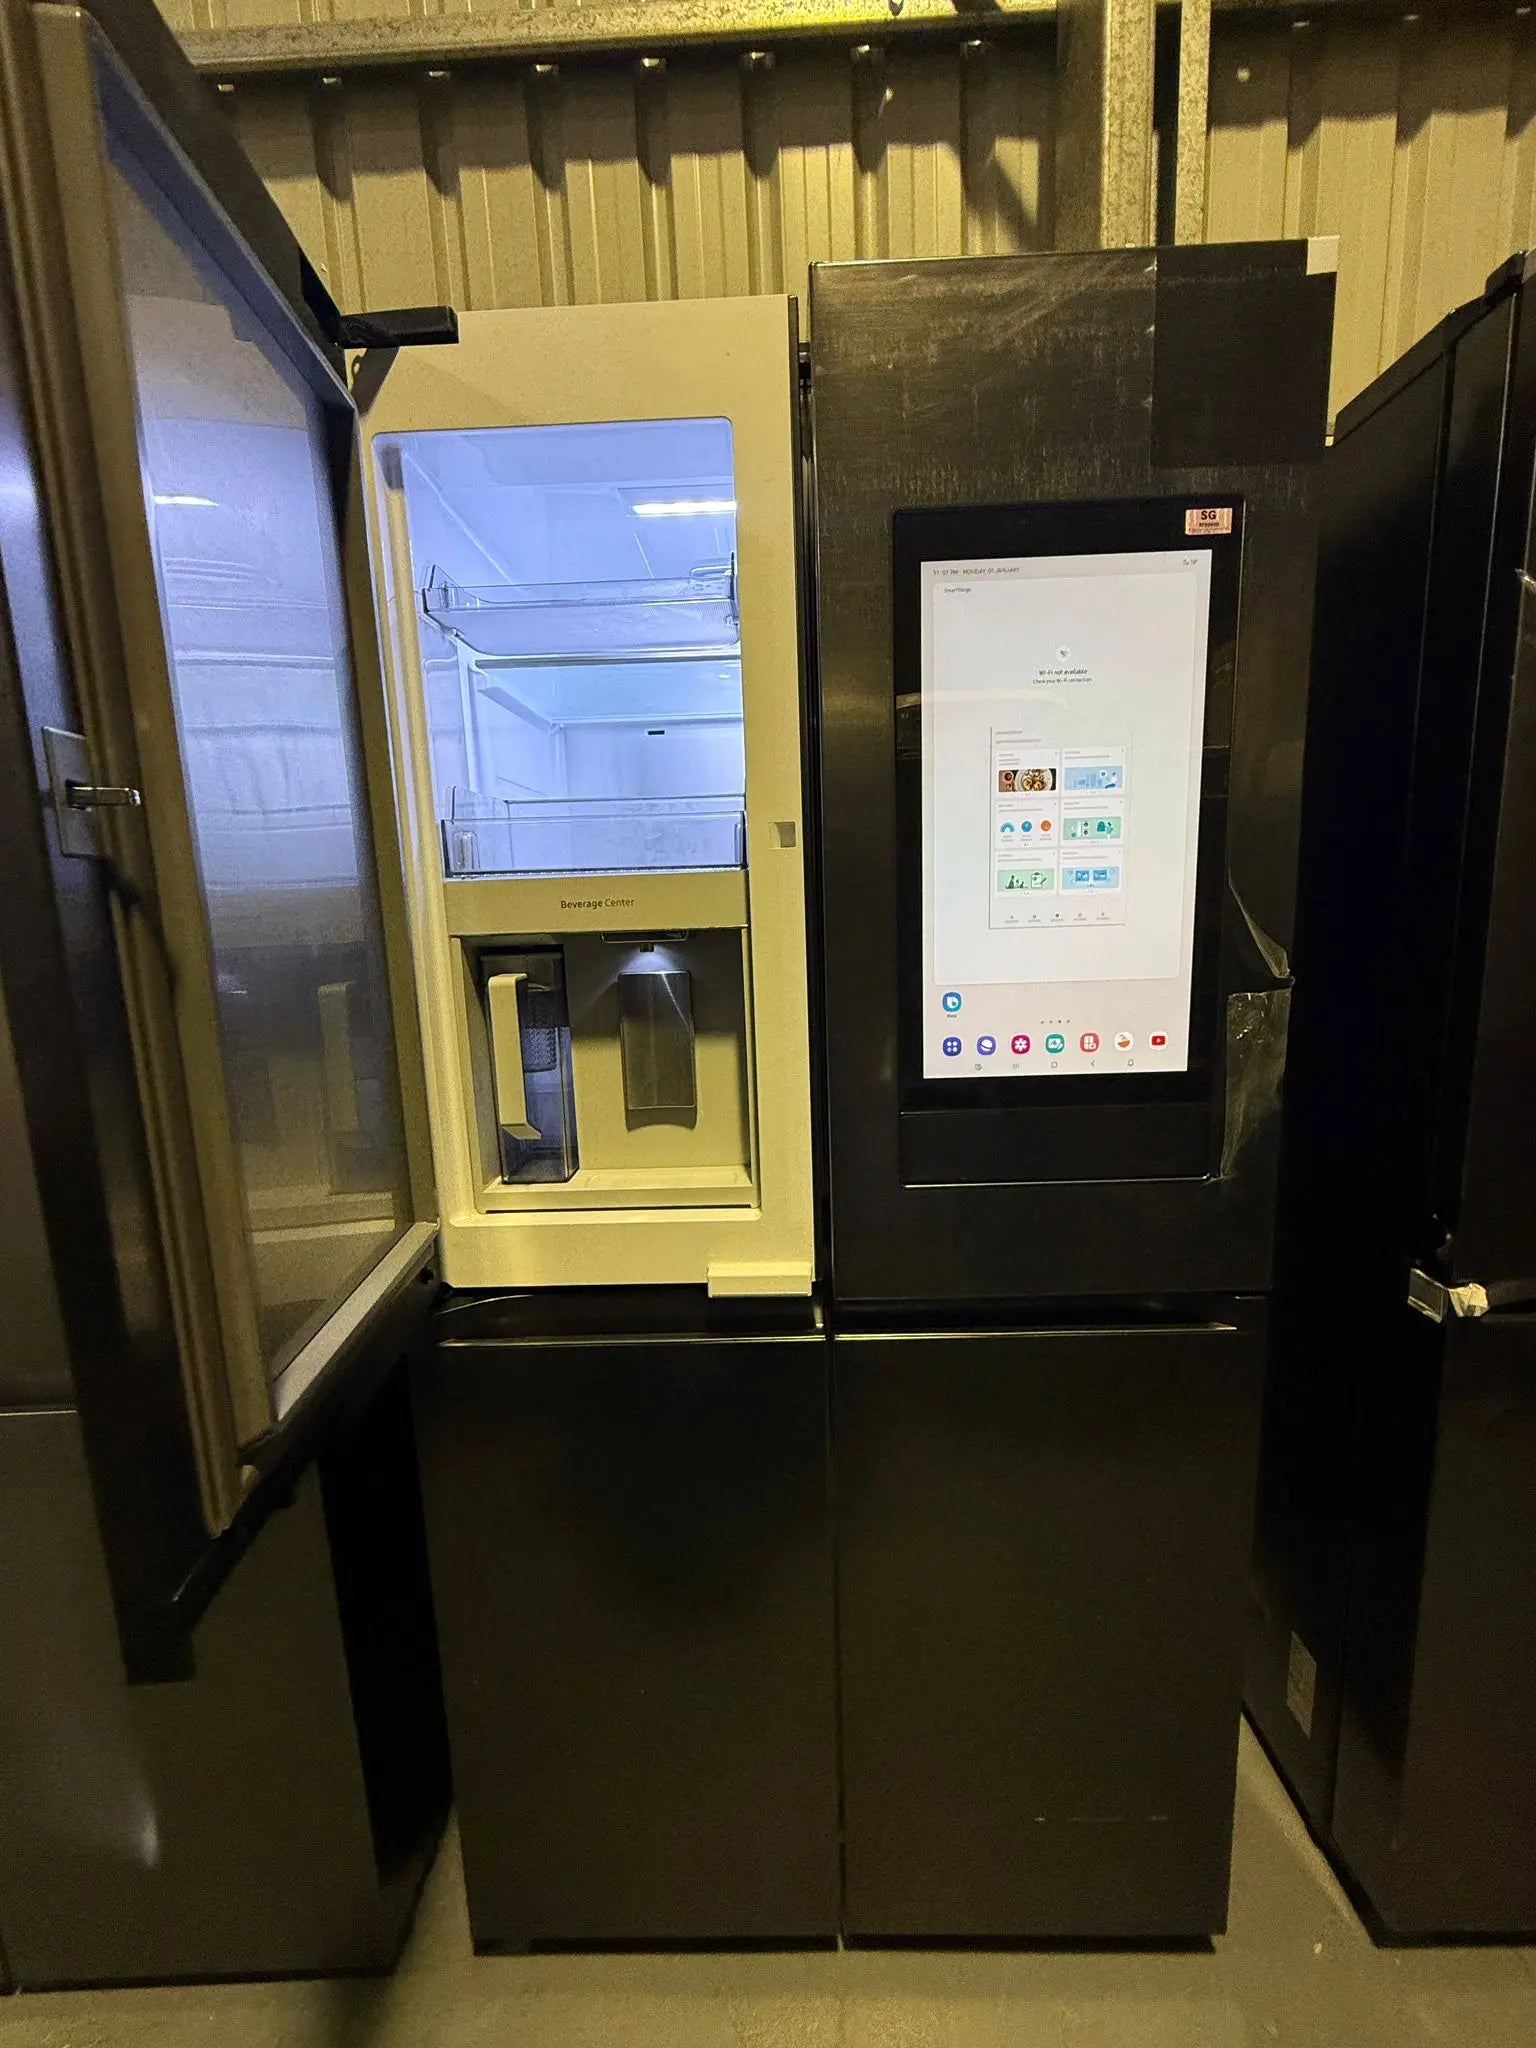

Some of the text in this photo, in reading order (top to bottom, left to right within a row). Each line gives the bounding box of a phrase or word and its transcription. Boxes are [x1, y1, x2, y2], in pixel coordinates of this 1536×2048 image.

[1200, 510, 1217, 520] SG
[560, 898, 636, 910] Beverage Center
